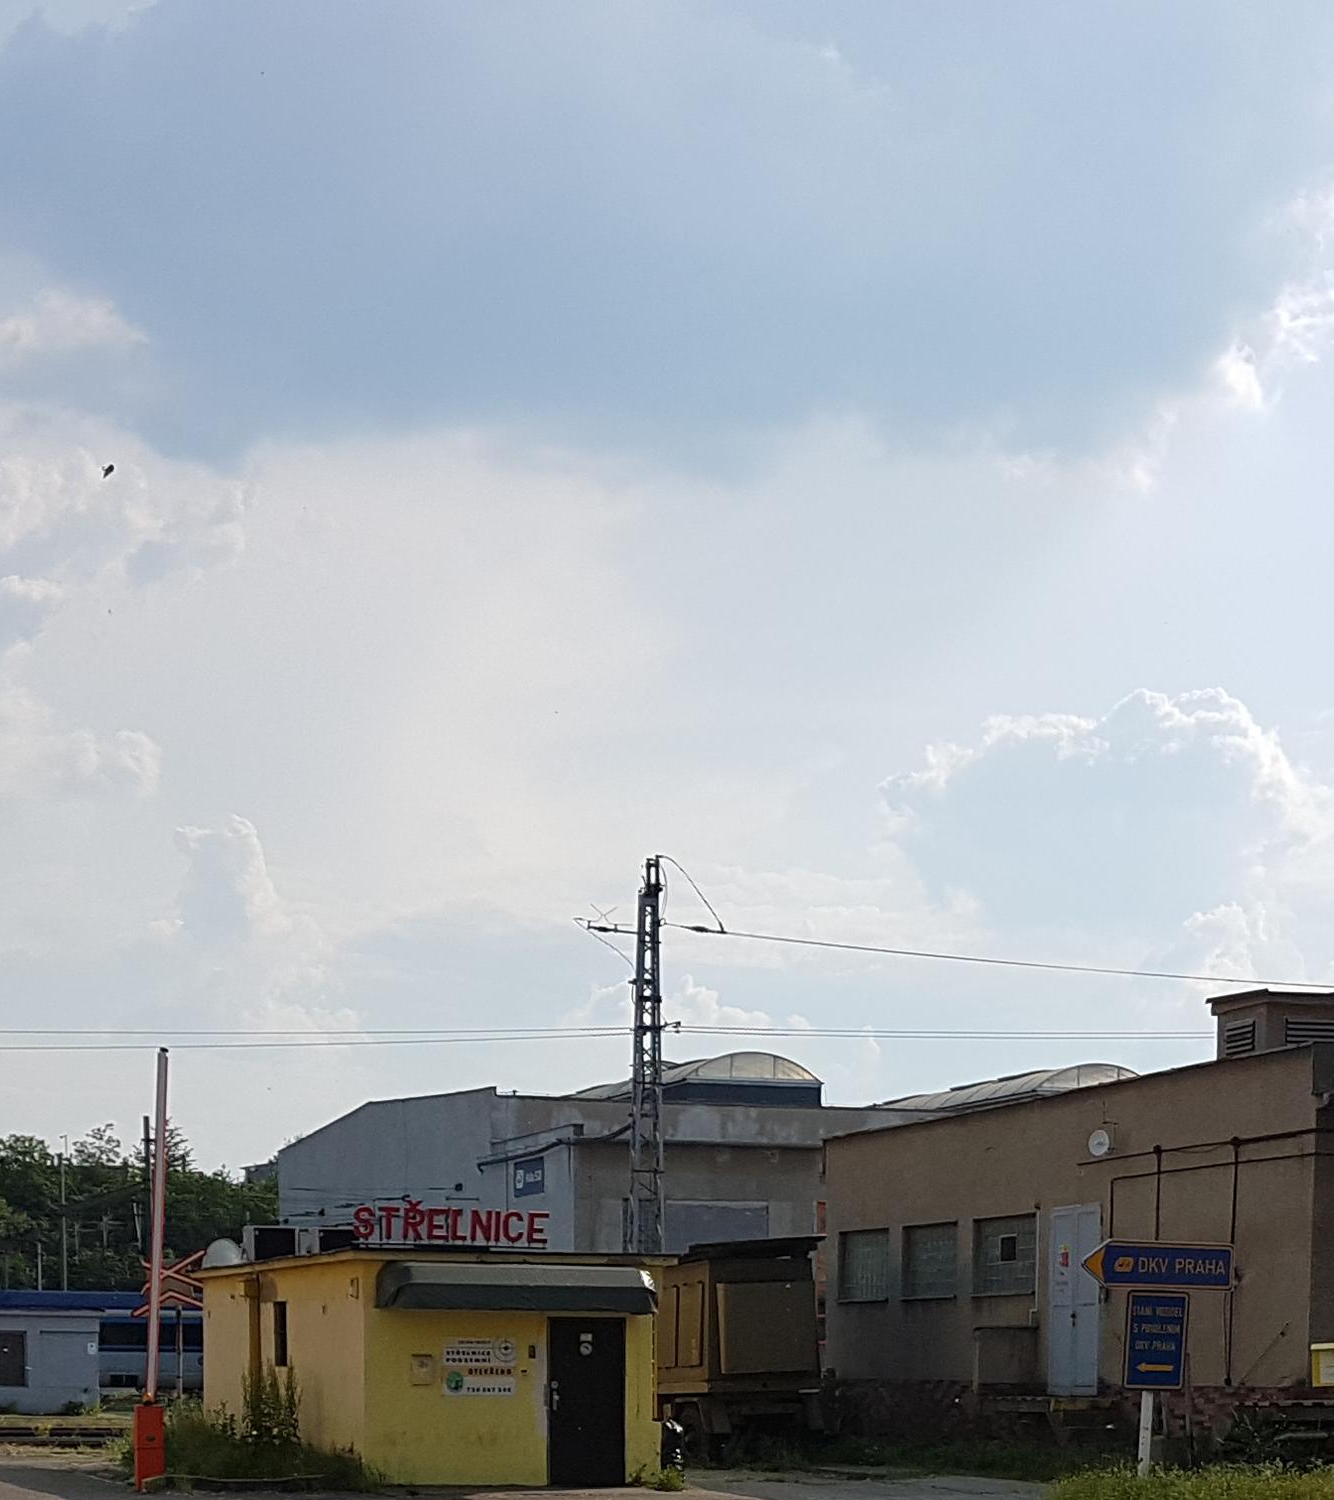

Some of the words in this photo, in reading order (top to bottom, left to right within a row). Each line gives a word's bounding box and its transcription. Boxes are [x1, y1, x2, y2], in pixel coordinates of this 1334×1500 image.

[353, 1200, 550, 1244] STŘELNICE
[1138, 1257, 1168, 1274] DKV
[1175, 1258, 1226, 1275] PRAHA
